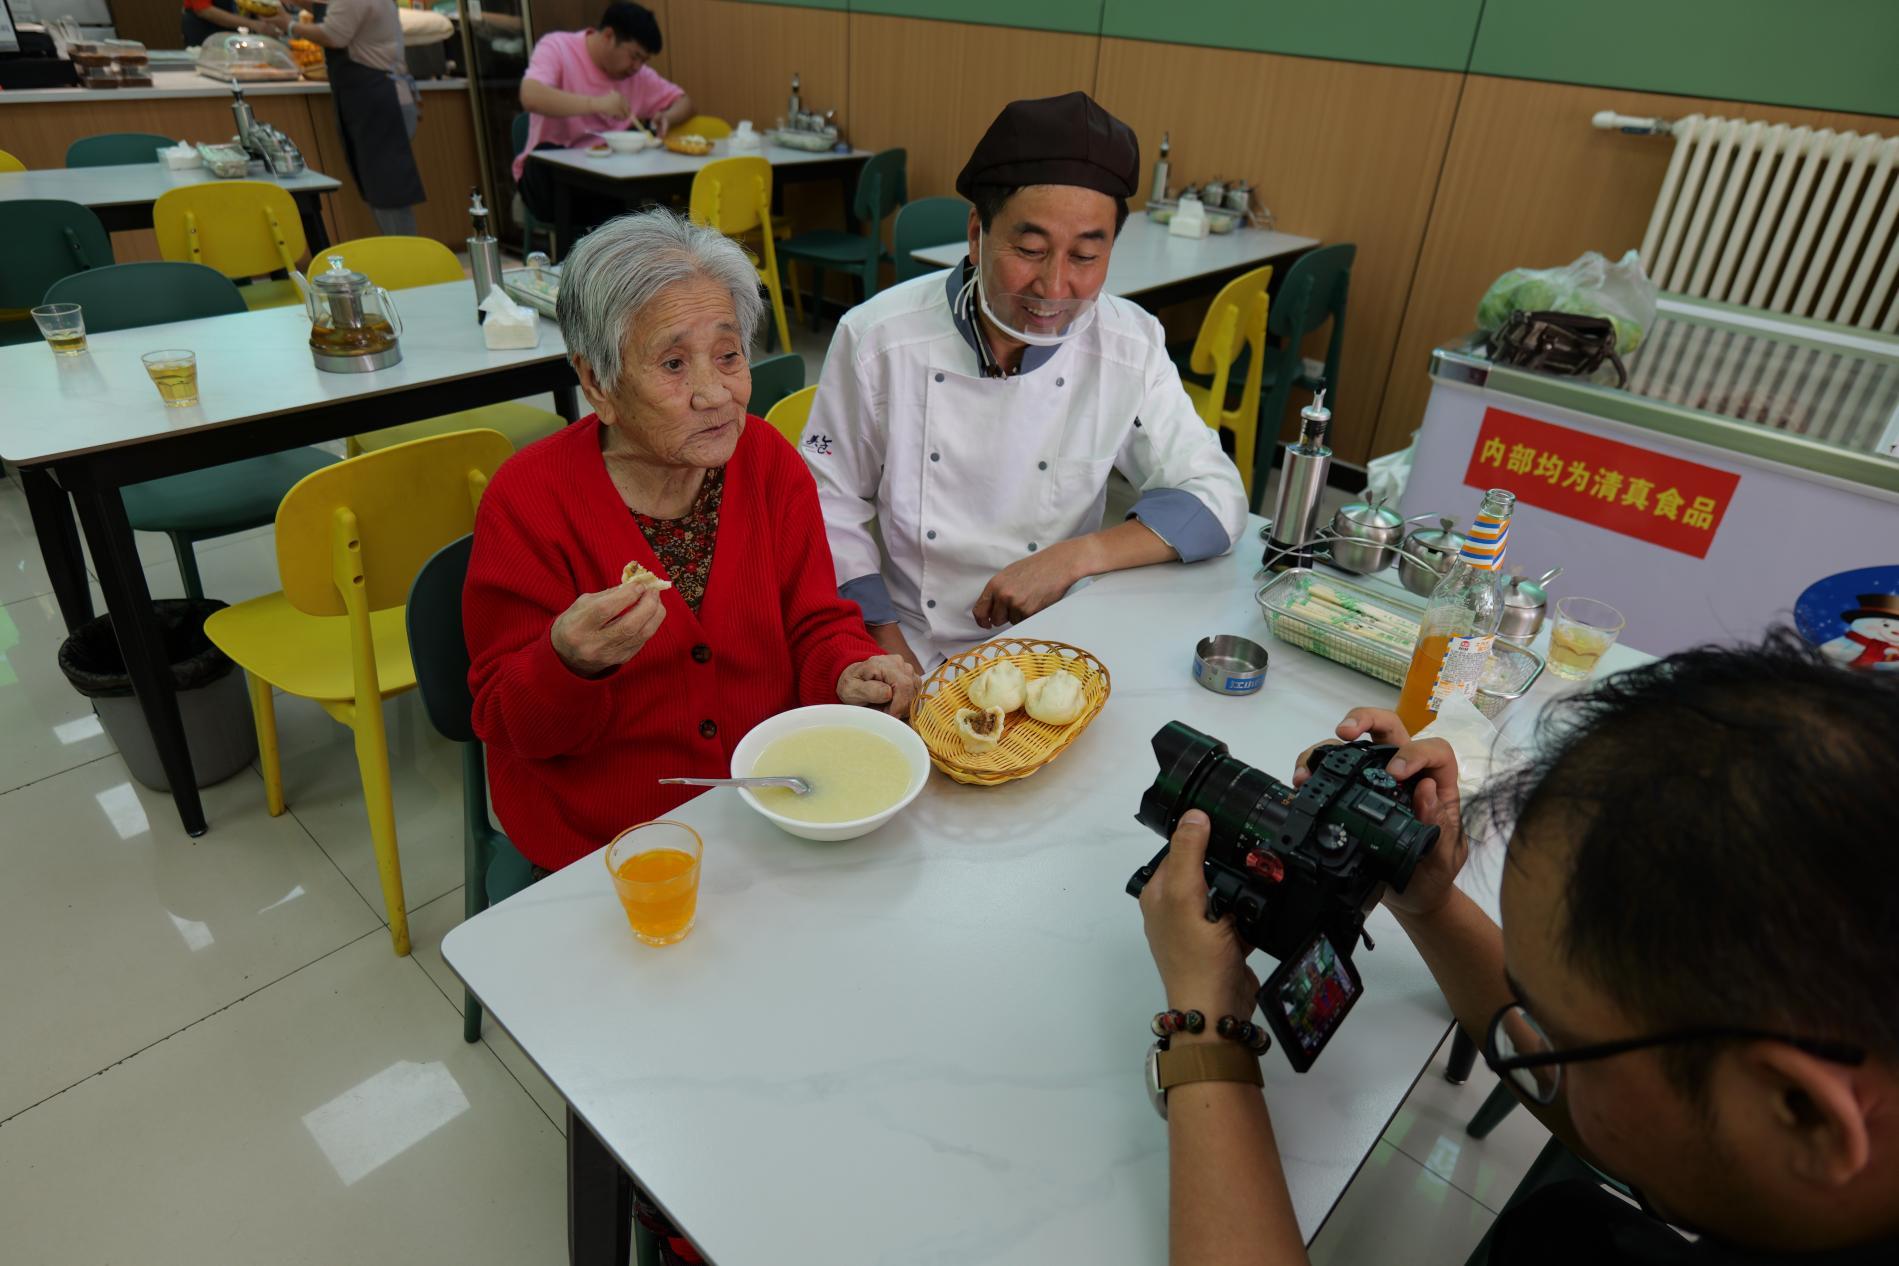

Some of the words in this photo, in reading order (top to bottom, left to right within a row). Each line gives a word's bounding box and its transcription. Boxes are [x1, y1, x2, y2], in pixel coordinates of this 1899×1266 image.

[1480, 437, 1717, 530] 内部均为清真食品
